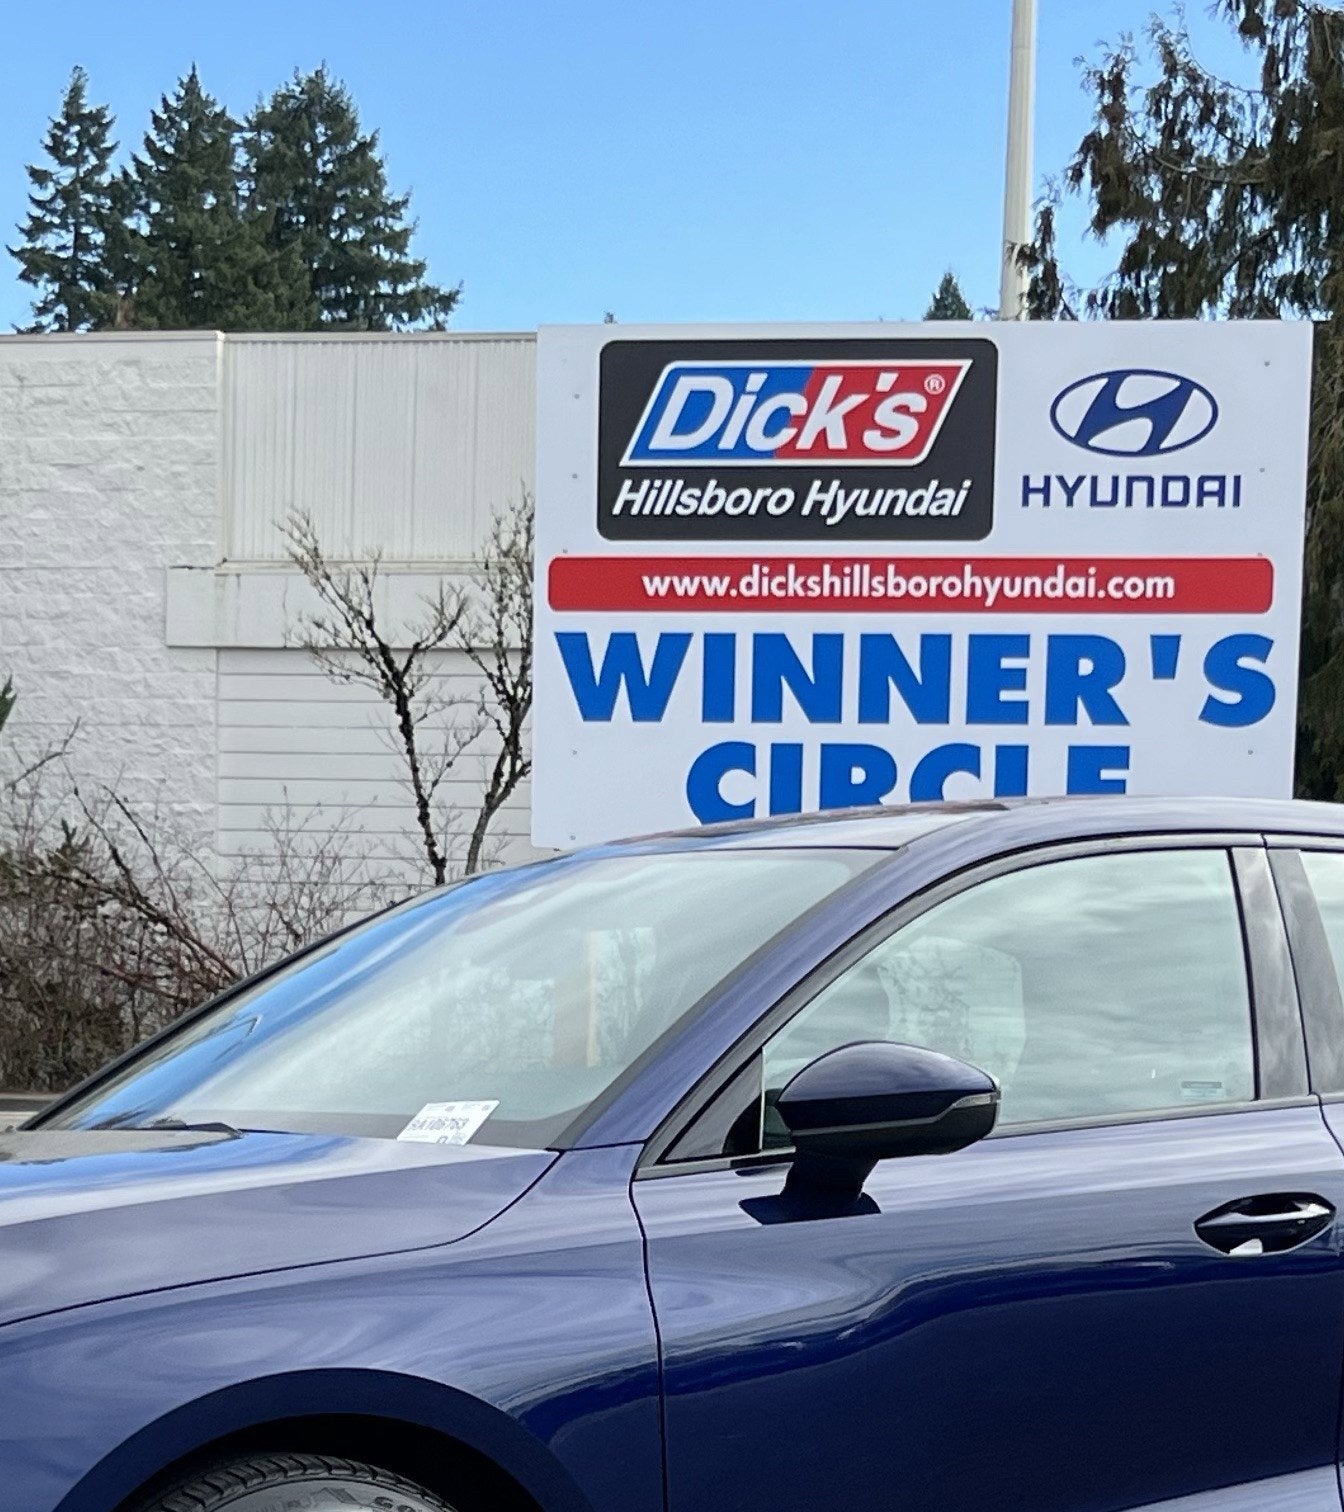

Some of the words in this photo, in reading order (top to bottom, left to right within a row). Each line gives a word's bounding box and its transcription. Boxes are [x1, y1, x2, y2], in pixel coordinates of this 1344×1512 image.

[611, 478, 795, 516] Hillsboro
[800, 478, 973, 526] Hyundai
[1021, 474, 1242, 508] HYUNDAI
[641, 563, 1176, 608] www.dickshillsborohyundai.com
[554, 631, 1277, 728] WINNER'S
